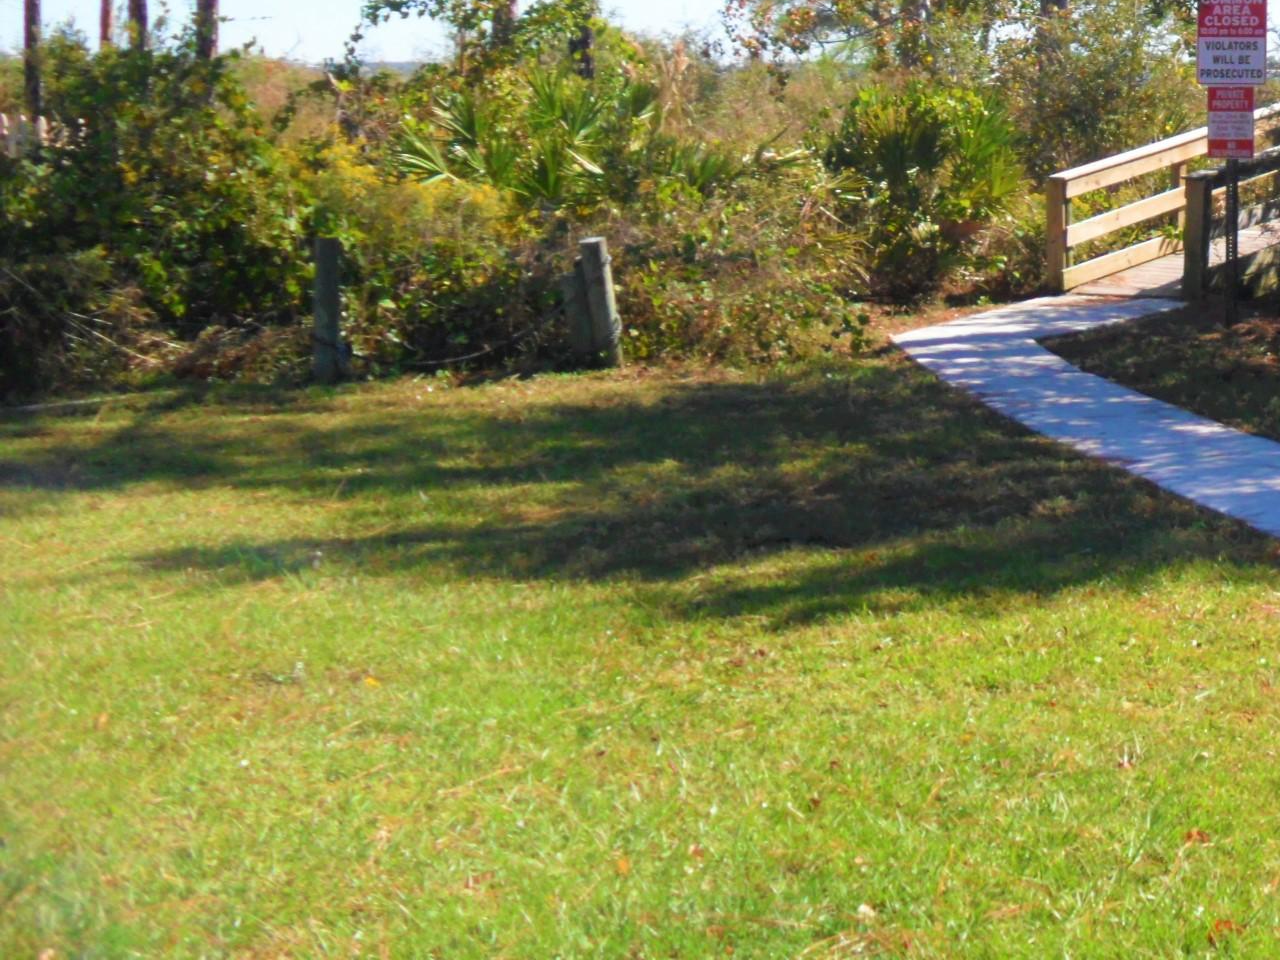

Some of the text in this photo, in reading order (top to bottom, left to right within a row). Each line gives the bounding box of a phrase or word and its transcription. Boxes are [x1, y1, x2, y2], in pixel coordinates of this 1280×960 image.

[1212, 5, 1251, 15] AREA
[1204, 15, 1260, 26] CLOSED
[1204, 41, 1258, 51] VIOLATORS
[1212, 55, 1251, 65] WILL BE
[1200, 69, 1263, 79] PROSECUTED
[1212, 100, 1248, 109] PROPERTY
